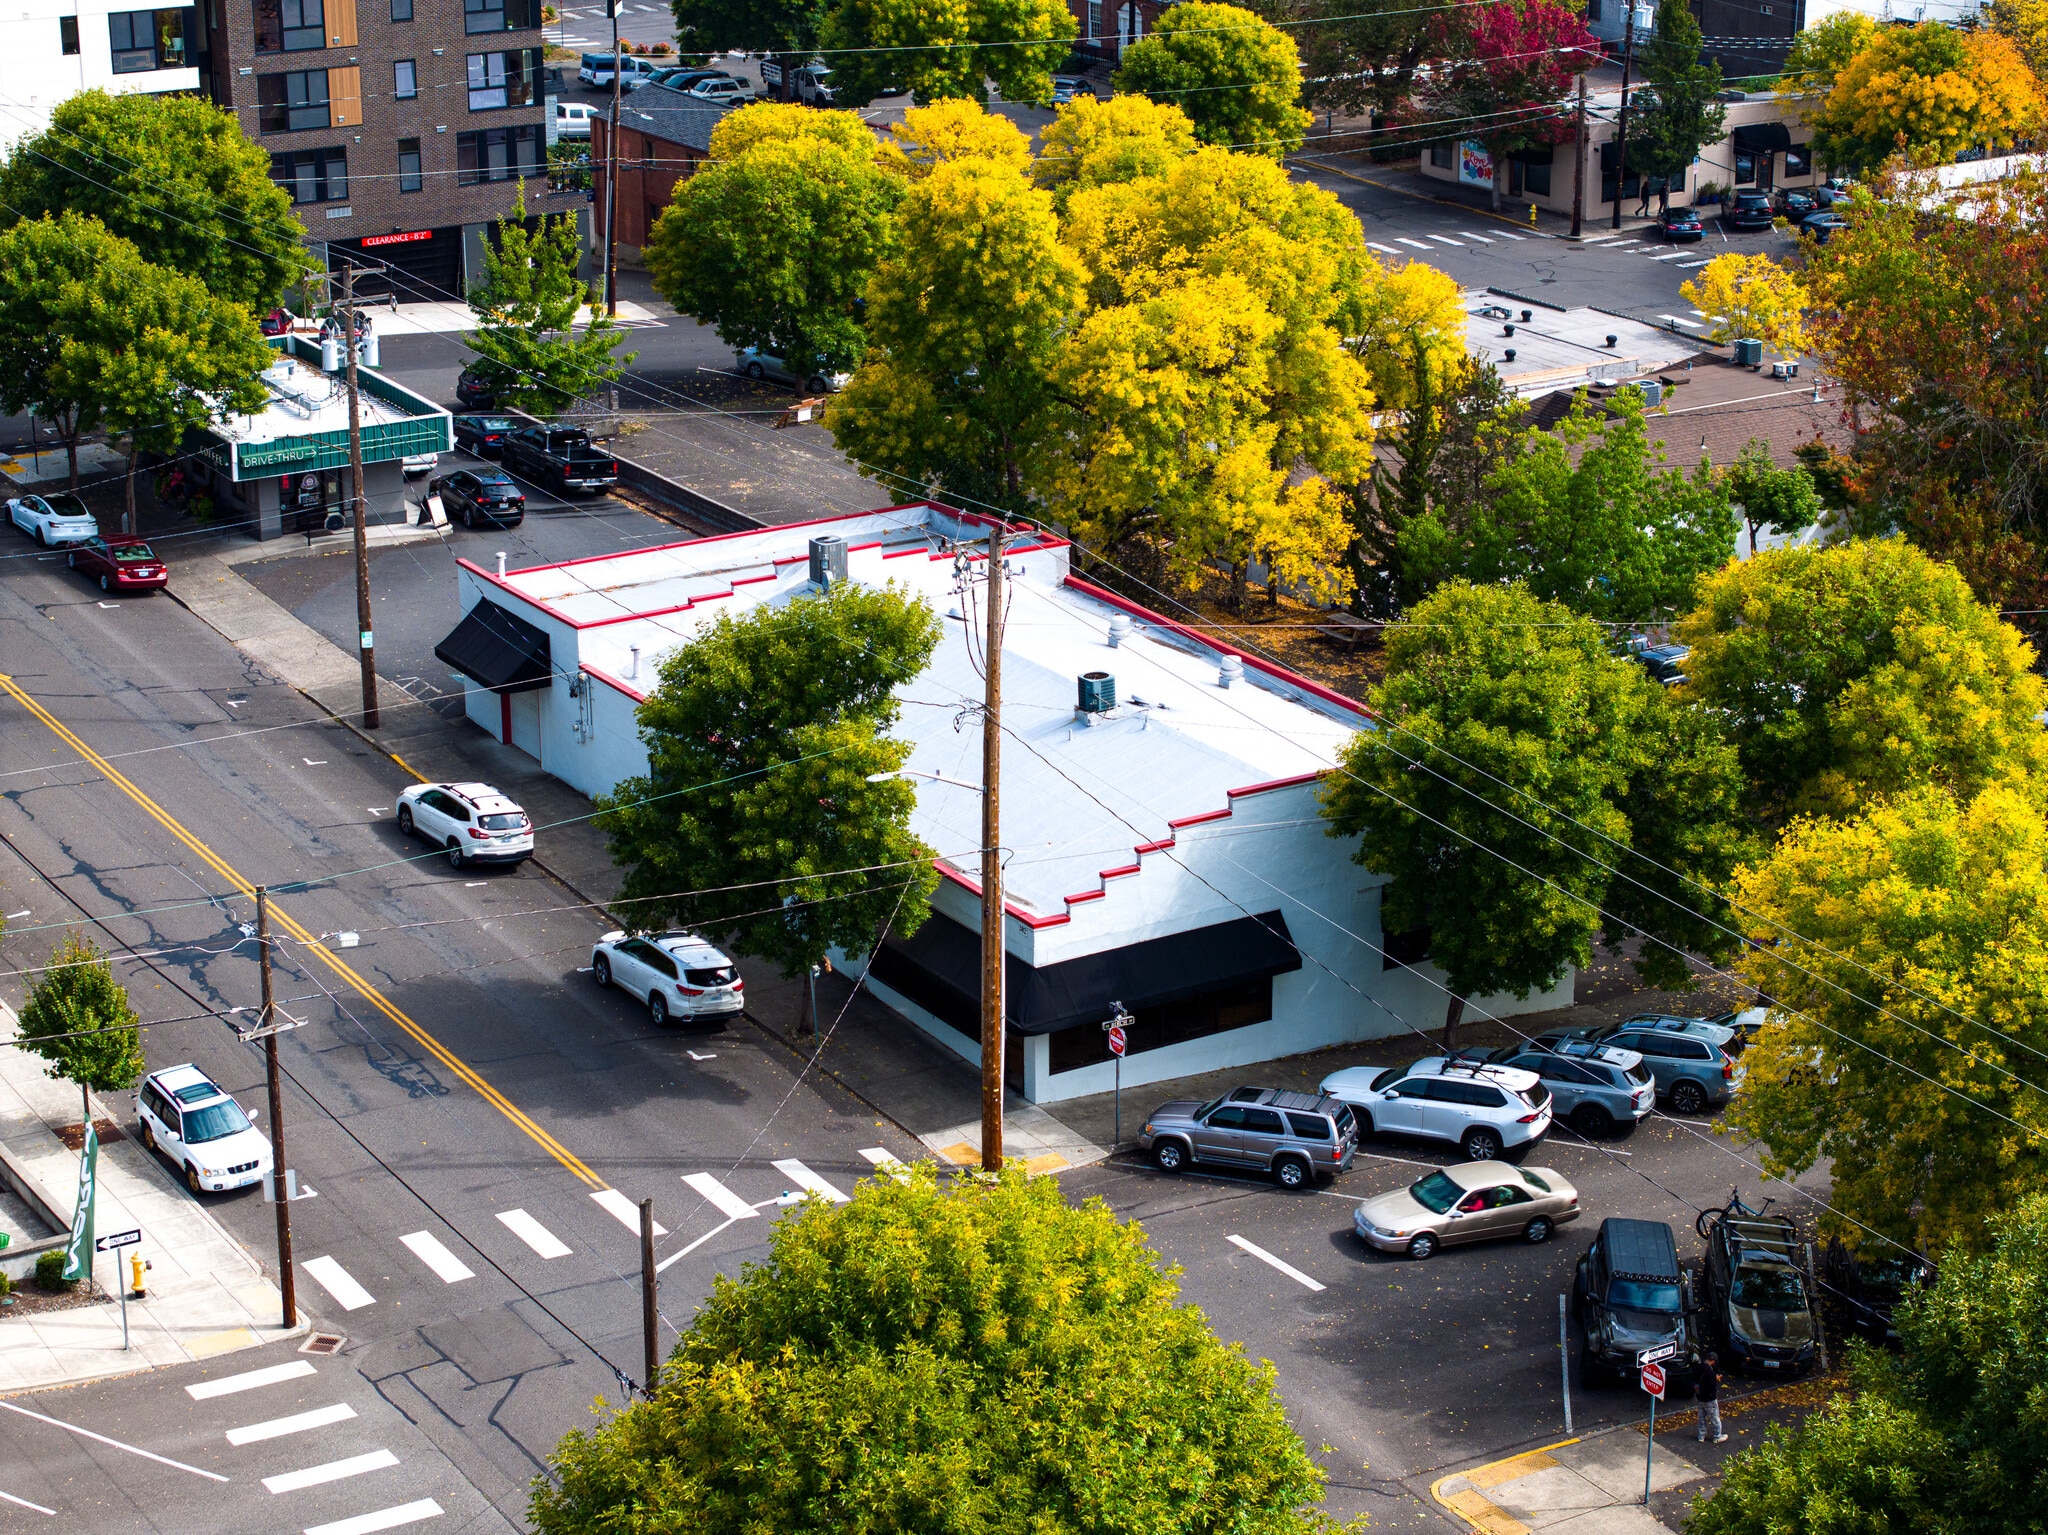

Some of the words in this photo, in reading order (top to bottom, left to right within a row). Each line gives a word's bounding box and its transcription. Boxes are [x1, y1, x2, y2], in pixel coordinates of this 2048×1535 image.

[366, 233, 409, 246] CLEARANCE
[200, 445, 223, 466] COFFEE
[244, 450, 304, 468] DRIVE-THRU
[109, 1237, 121, 1246] ONE
[123, 1233, 137, 1242] WAY
[1648, 1352, 1659, 1360] ONE
[1660, 1347, 1672, 1355] WAY
[1652, 1370, 1661, 1378] NOT
[1646, 1380, 1659, 1390] ENTER
